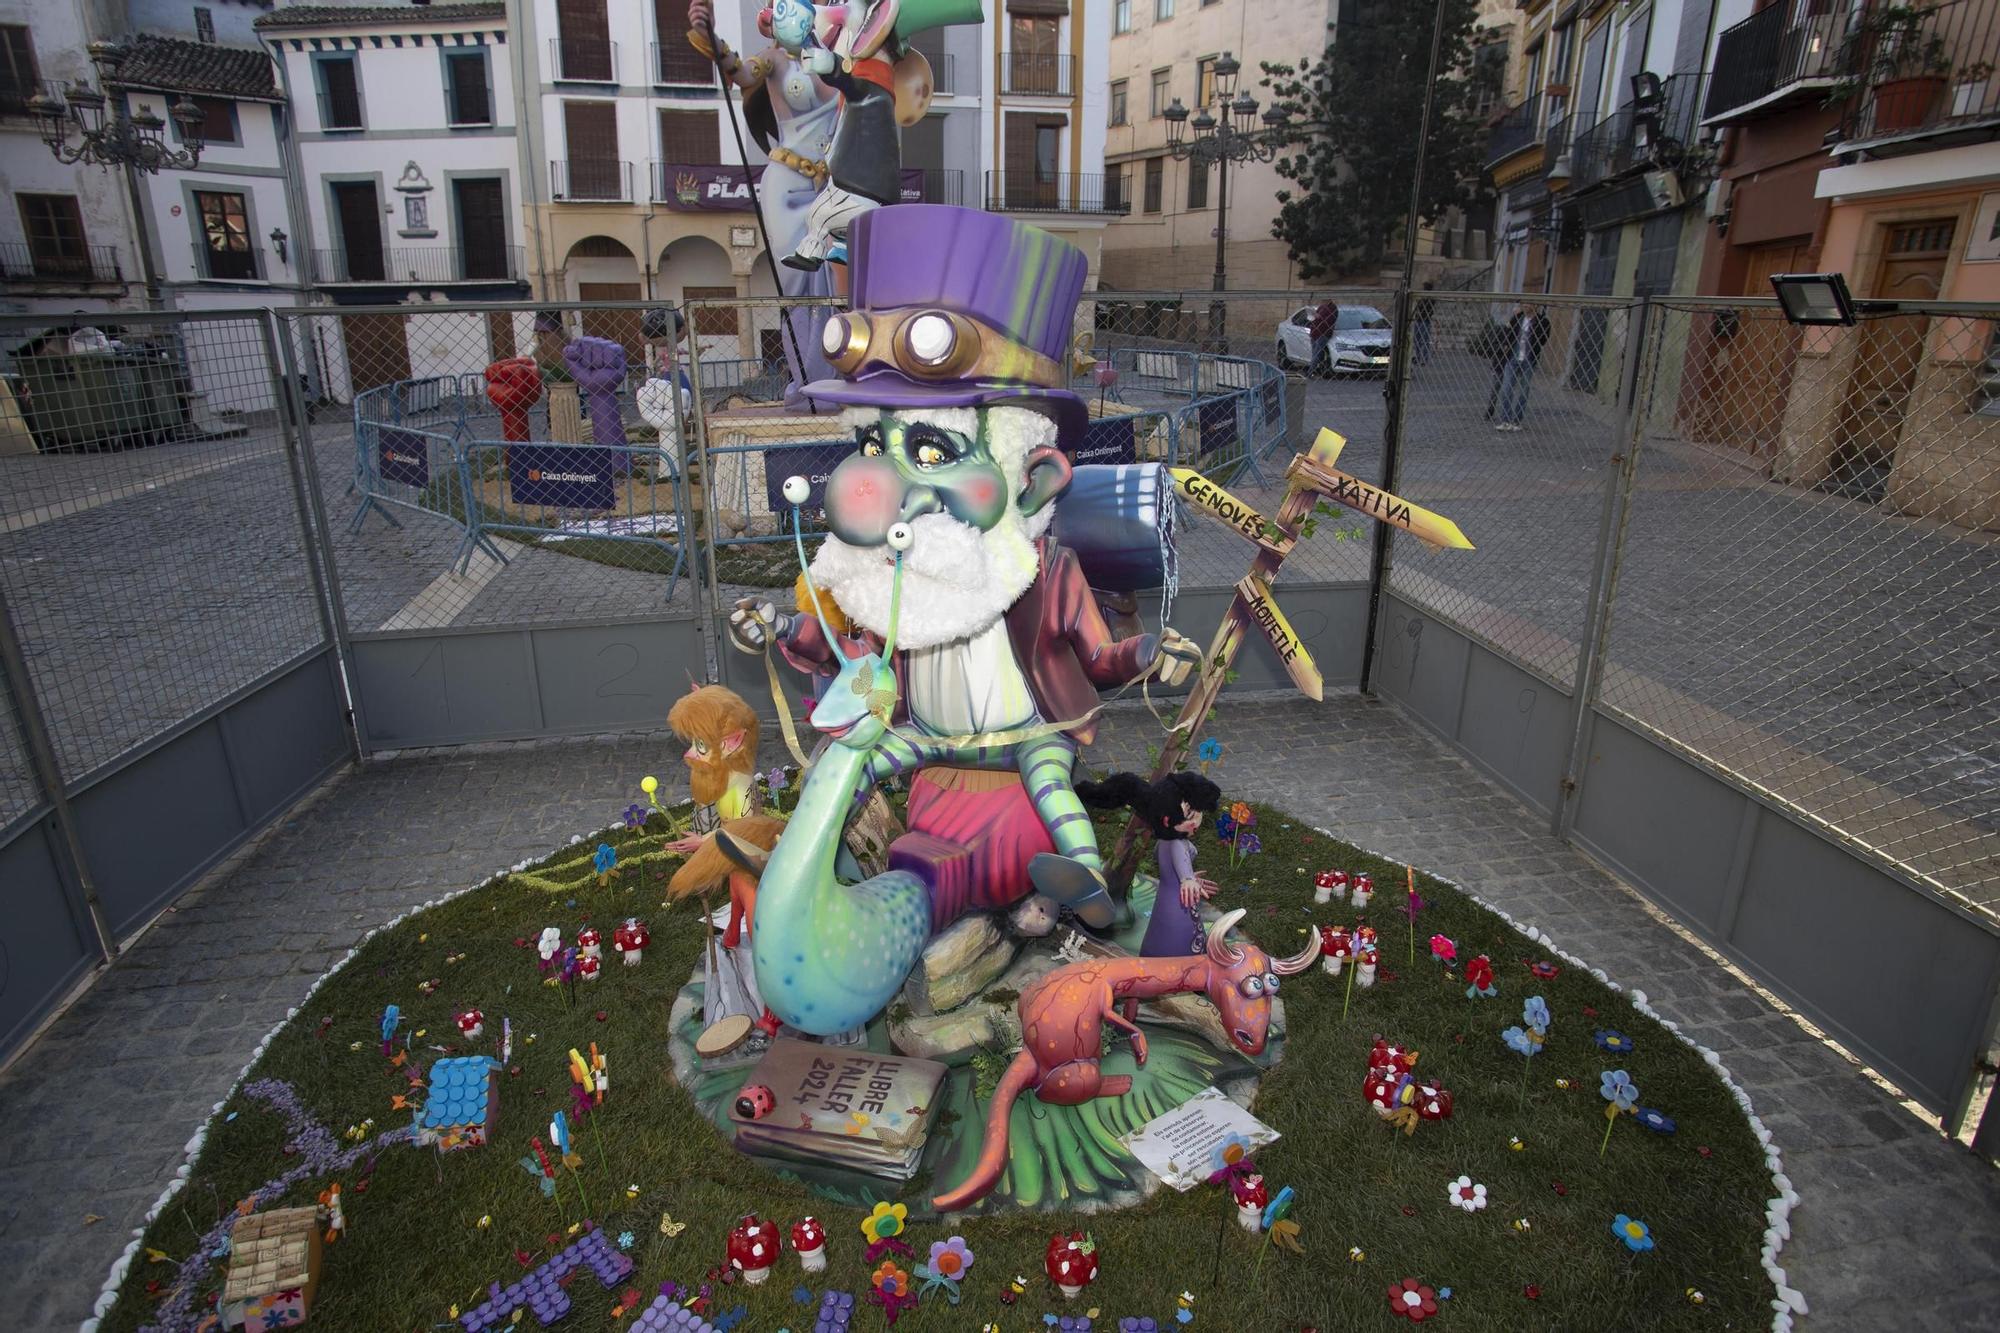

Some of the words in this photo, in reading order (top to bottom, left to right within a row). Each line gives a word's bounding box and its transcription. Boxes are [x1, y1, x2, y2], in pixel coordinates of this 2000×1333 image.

[541, 471, 561, 481] Caixa
[561, 471, 597, 484] Ontinyent
[810, 473, 833, 484] Caix
[1076, 448, 1094, 459] Caixa
[1183, 475, 1265, 541] GENOVÉS
[1330, 475, 1412, 529] XÀTIVA
[1250, 595, 1298, 666] NOVETLÈ
[792, 1057, 836, 1105] 2024
[819, 1057, 875, 1114] FALLER
[858, 1061, 902, 1115] LLIBRE
